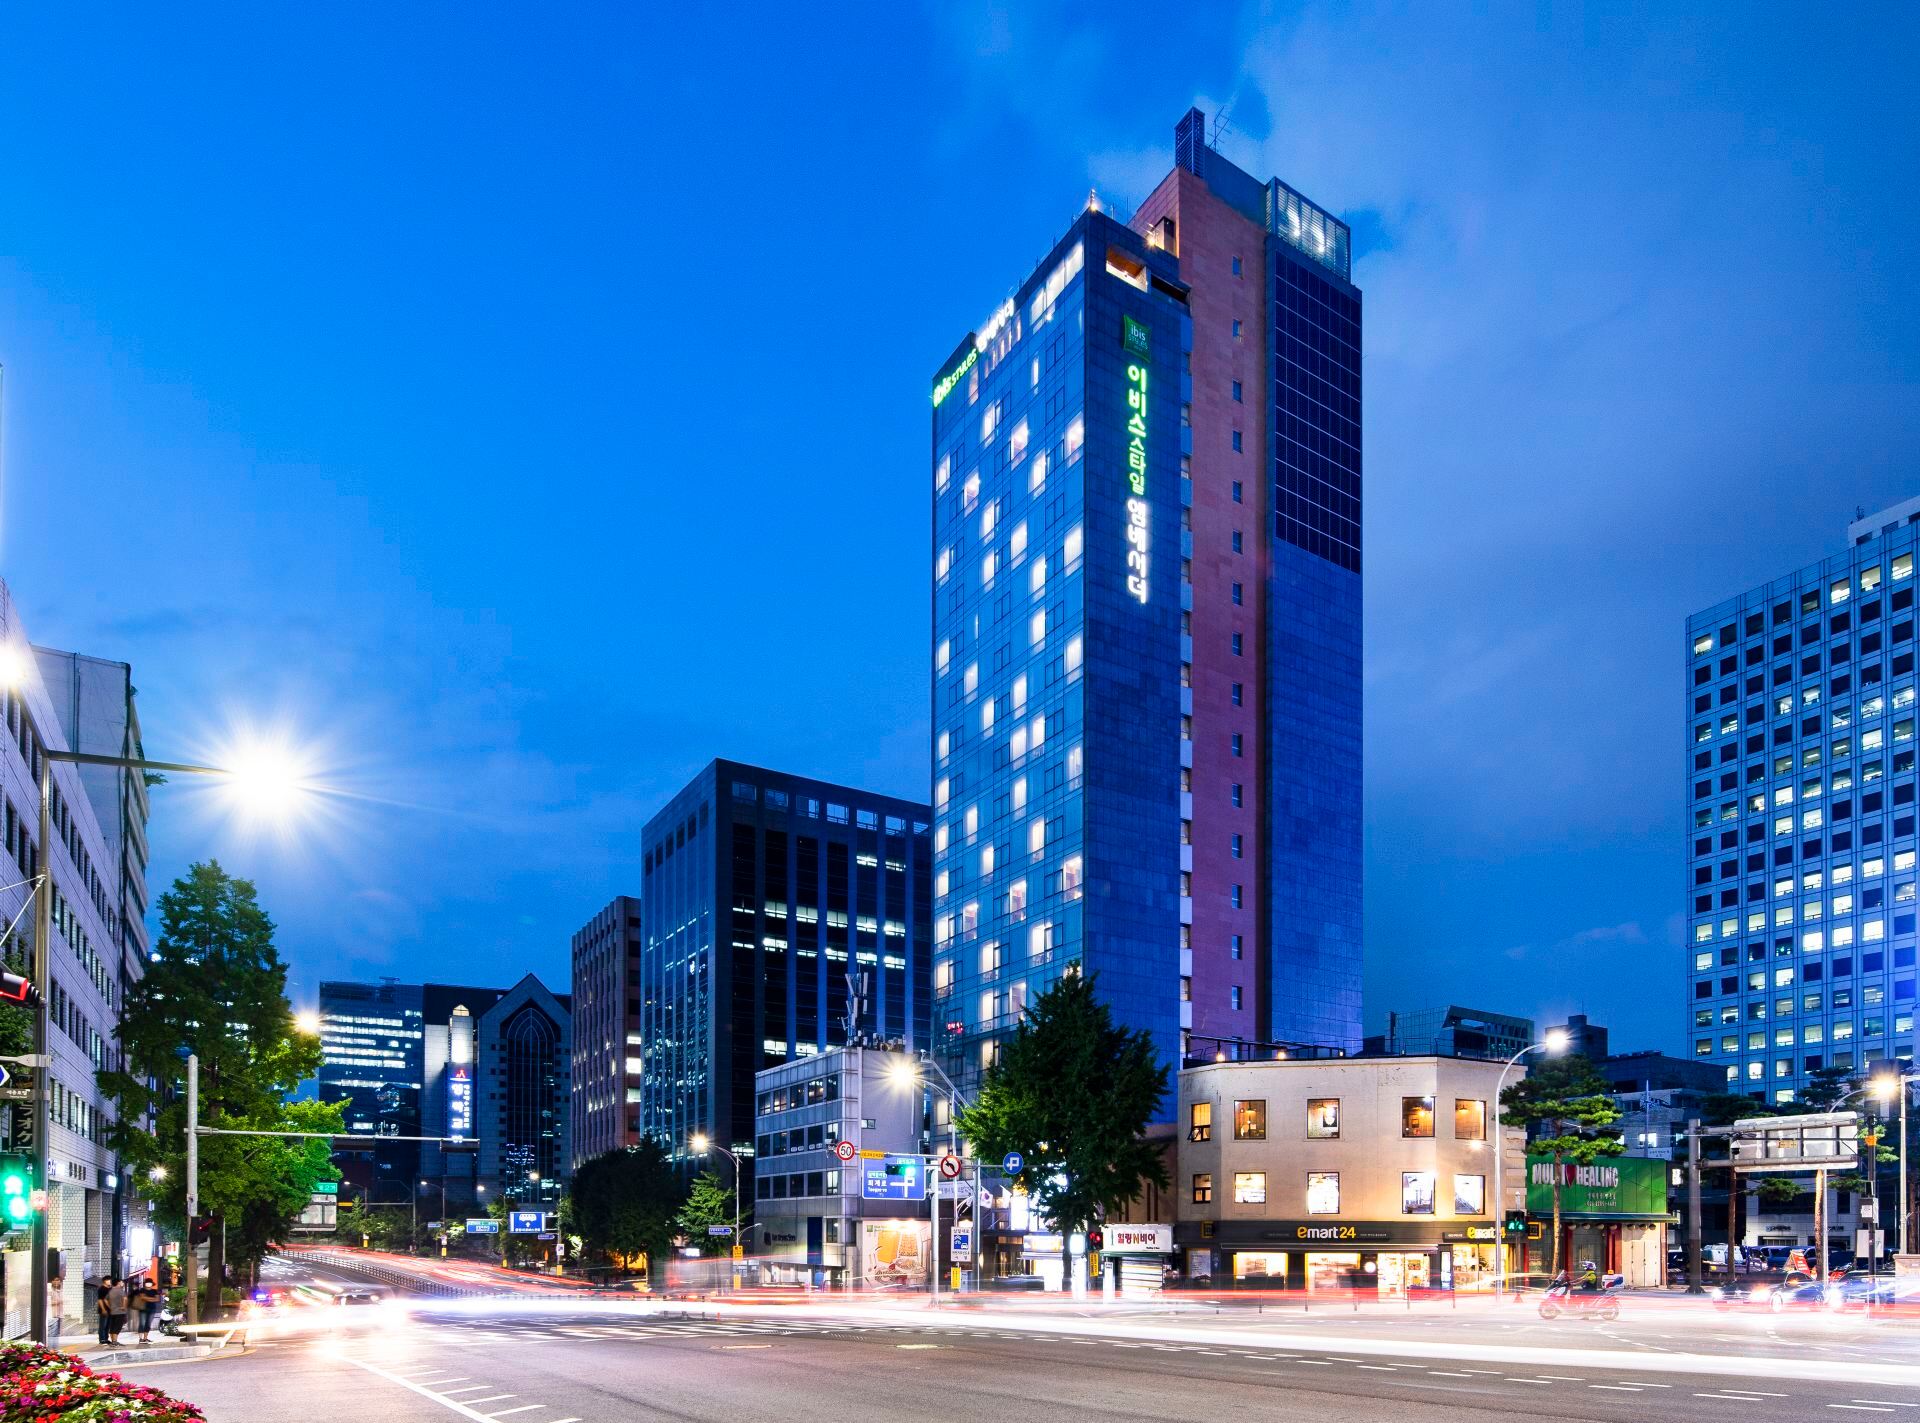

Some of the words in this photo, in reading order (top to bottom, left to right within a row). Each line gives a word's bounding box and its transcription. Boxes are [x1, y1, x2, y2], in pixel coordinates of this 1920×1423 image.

[1131, 324, 1146, 341] ibis
[840, 1145, 852, 1156] 50
[1532, 1163, 1566, 1186] MULI
[1576, 1166, 1619, 1188] HEALING
[1297, 1226, 1356, 1239] emart24
